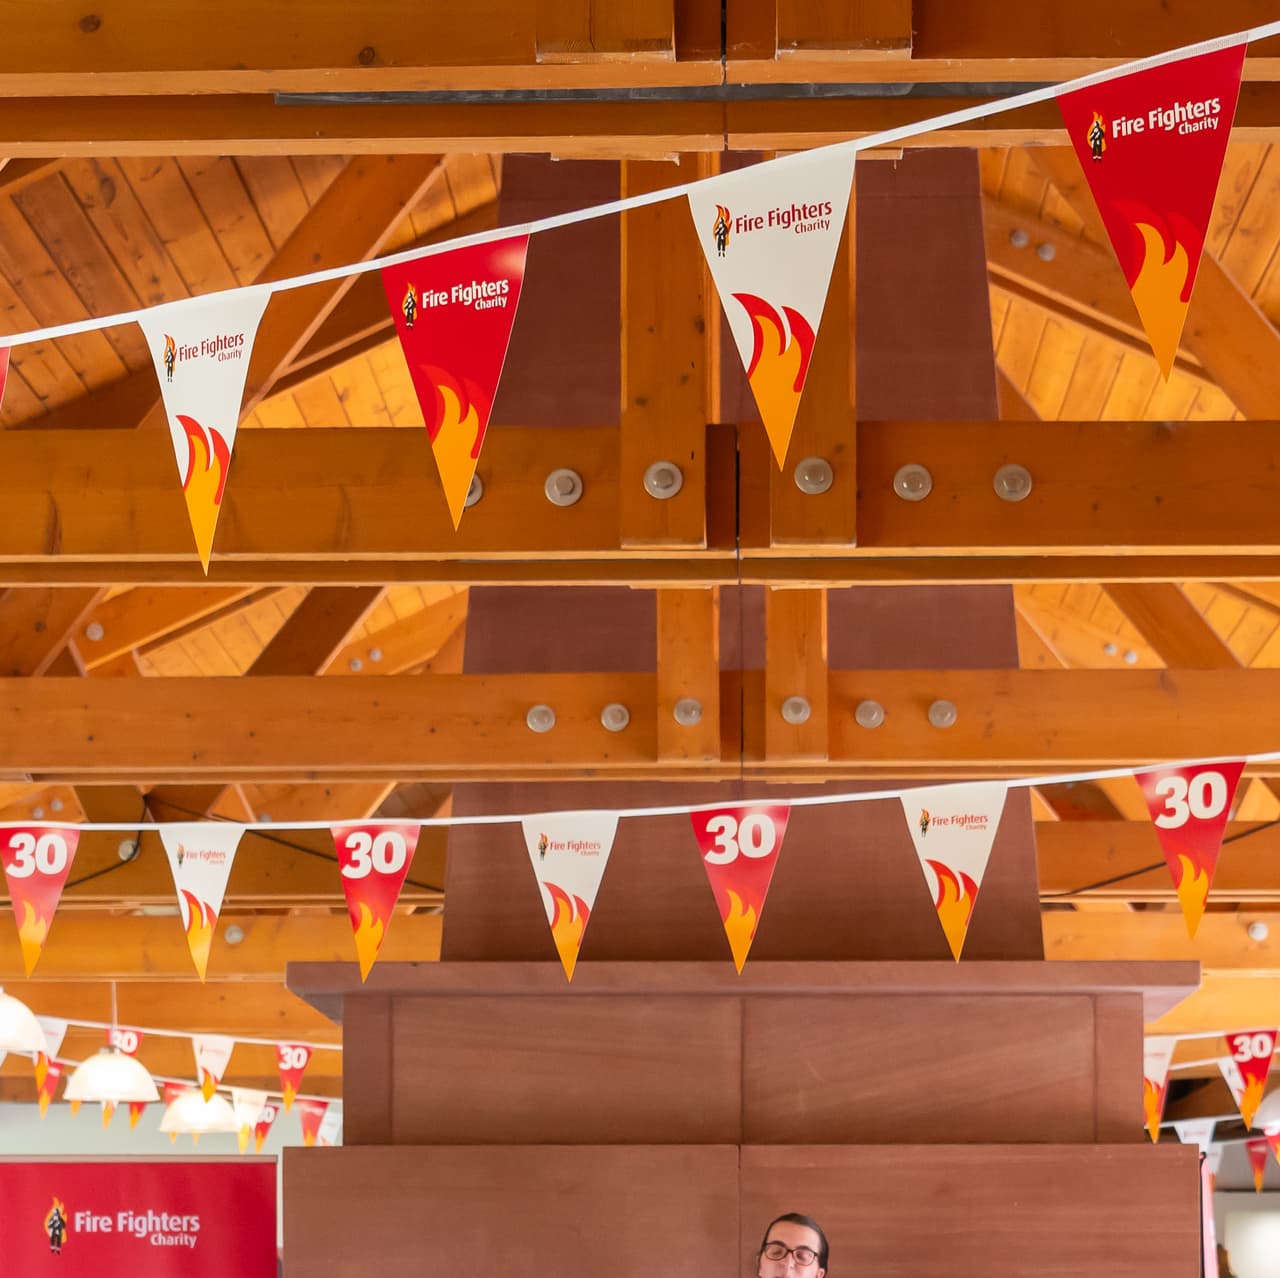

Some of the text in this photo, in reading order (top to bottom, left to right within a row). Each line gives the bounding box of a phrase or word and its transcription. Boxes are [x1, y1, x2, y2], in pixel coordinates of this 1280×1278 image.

[1112, 98, 1221, 138] Fire Fighters
[1179, 114, 1219, 135] Charity
[735, 201, 832, 234] Fire Fighters
[794, 219, 830, 234] Charity
[422, 280, 509, 309] Fire Fighters
[474, 295, 508, 310] Charity
[179, 333, 244, 362] Fire Fighters
[218, 348, 242, 362] Charity
[1154, 771, 1227, 829] 30
[932, 814, 988, 827] Fire Fighters
[550, 840, 600, 853] Fire Fighters
[704, 813, 776, 865] 30
[5, 832, 67, 878] 30
[341, 831, 406, 879] 30
[279, 1046, 309, 1070] 30
[1232, 1033, 1273, 1063] 30
[74, 1209, 200, 1238] Fire Fighters
[150, 1232, 197, 1249] Charity
